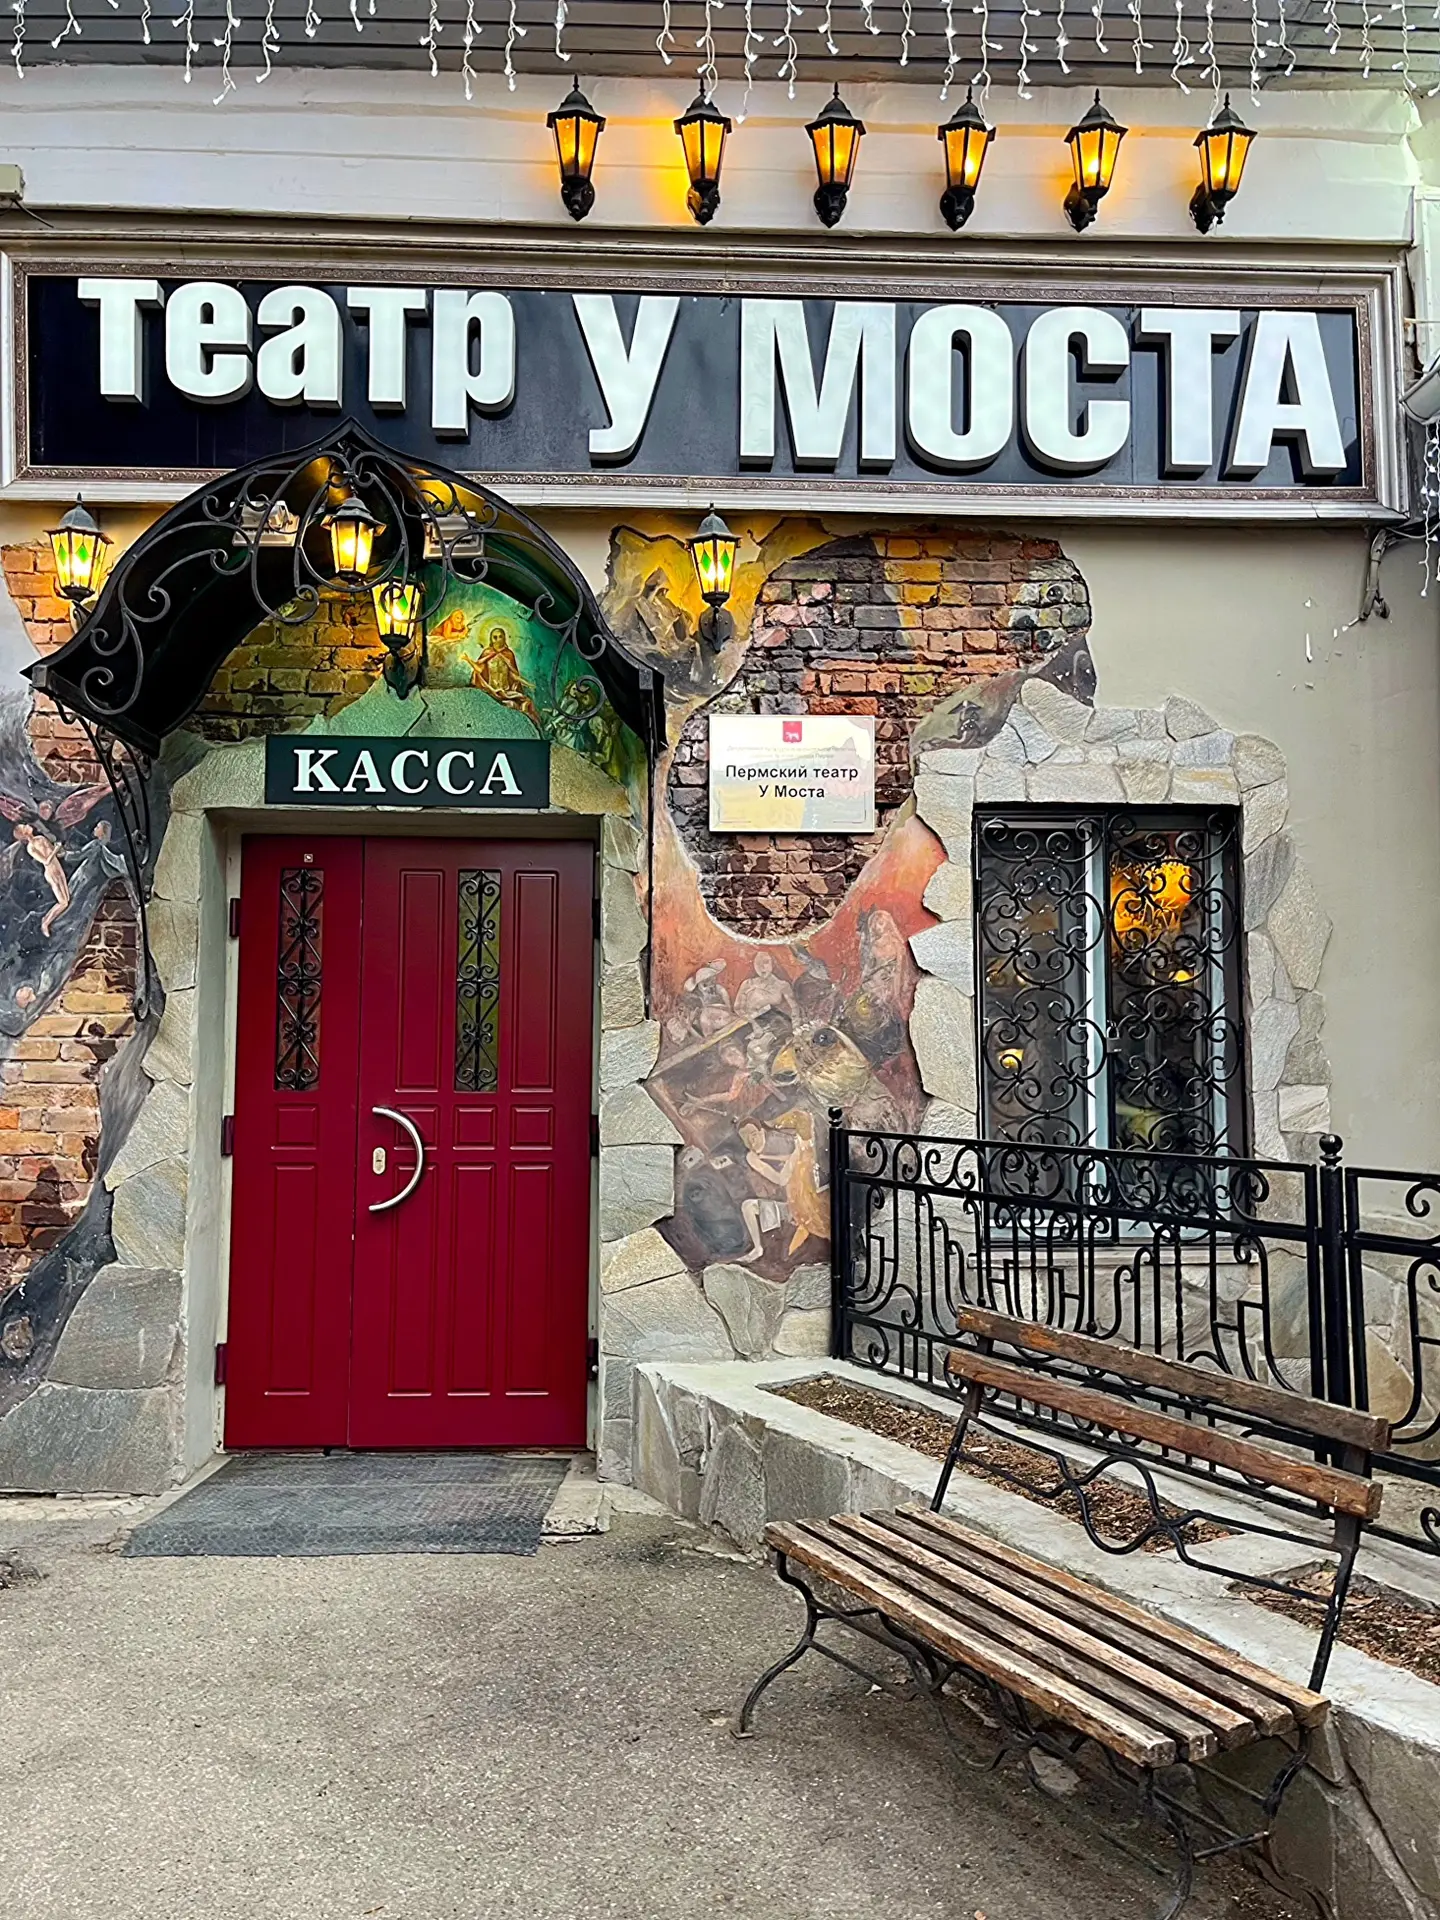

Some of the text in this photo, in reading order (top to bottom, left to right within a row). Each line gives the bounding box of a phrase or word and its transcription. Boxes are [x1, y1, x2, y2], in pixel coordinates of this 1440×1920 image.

[77, 277, 516, 437] театр
[740, 298, 1348, 476] МОСТА
[292, 749, 523, 796] КАССА
[725, 765, 859, 781] Пермский театр
[759, 784, 825, 798] У Моста
